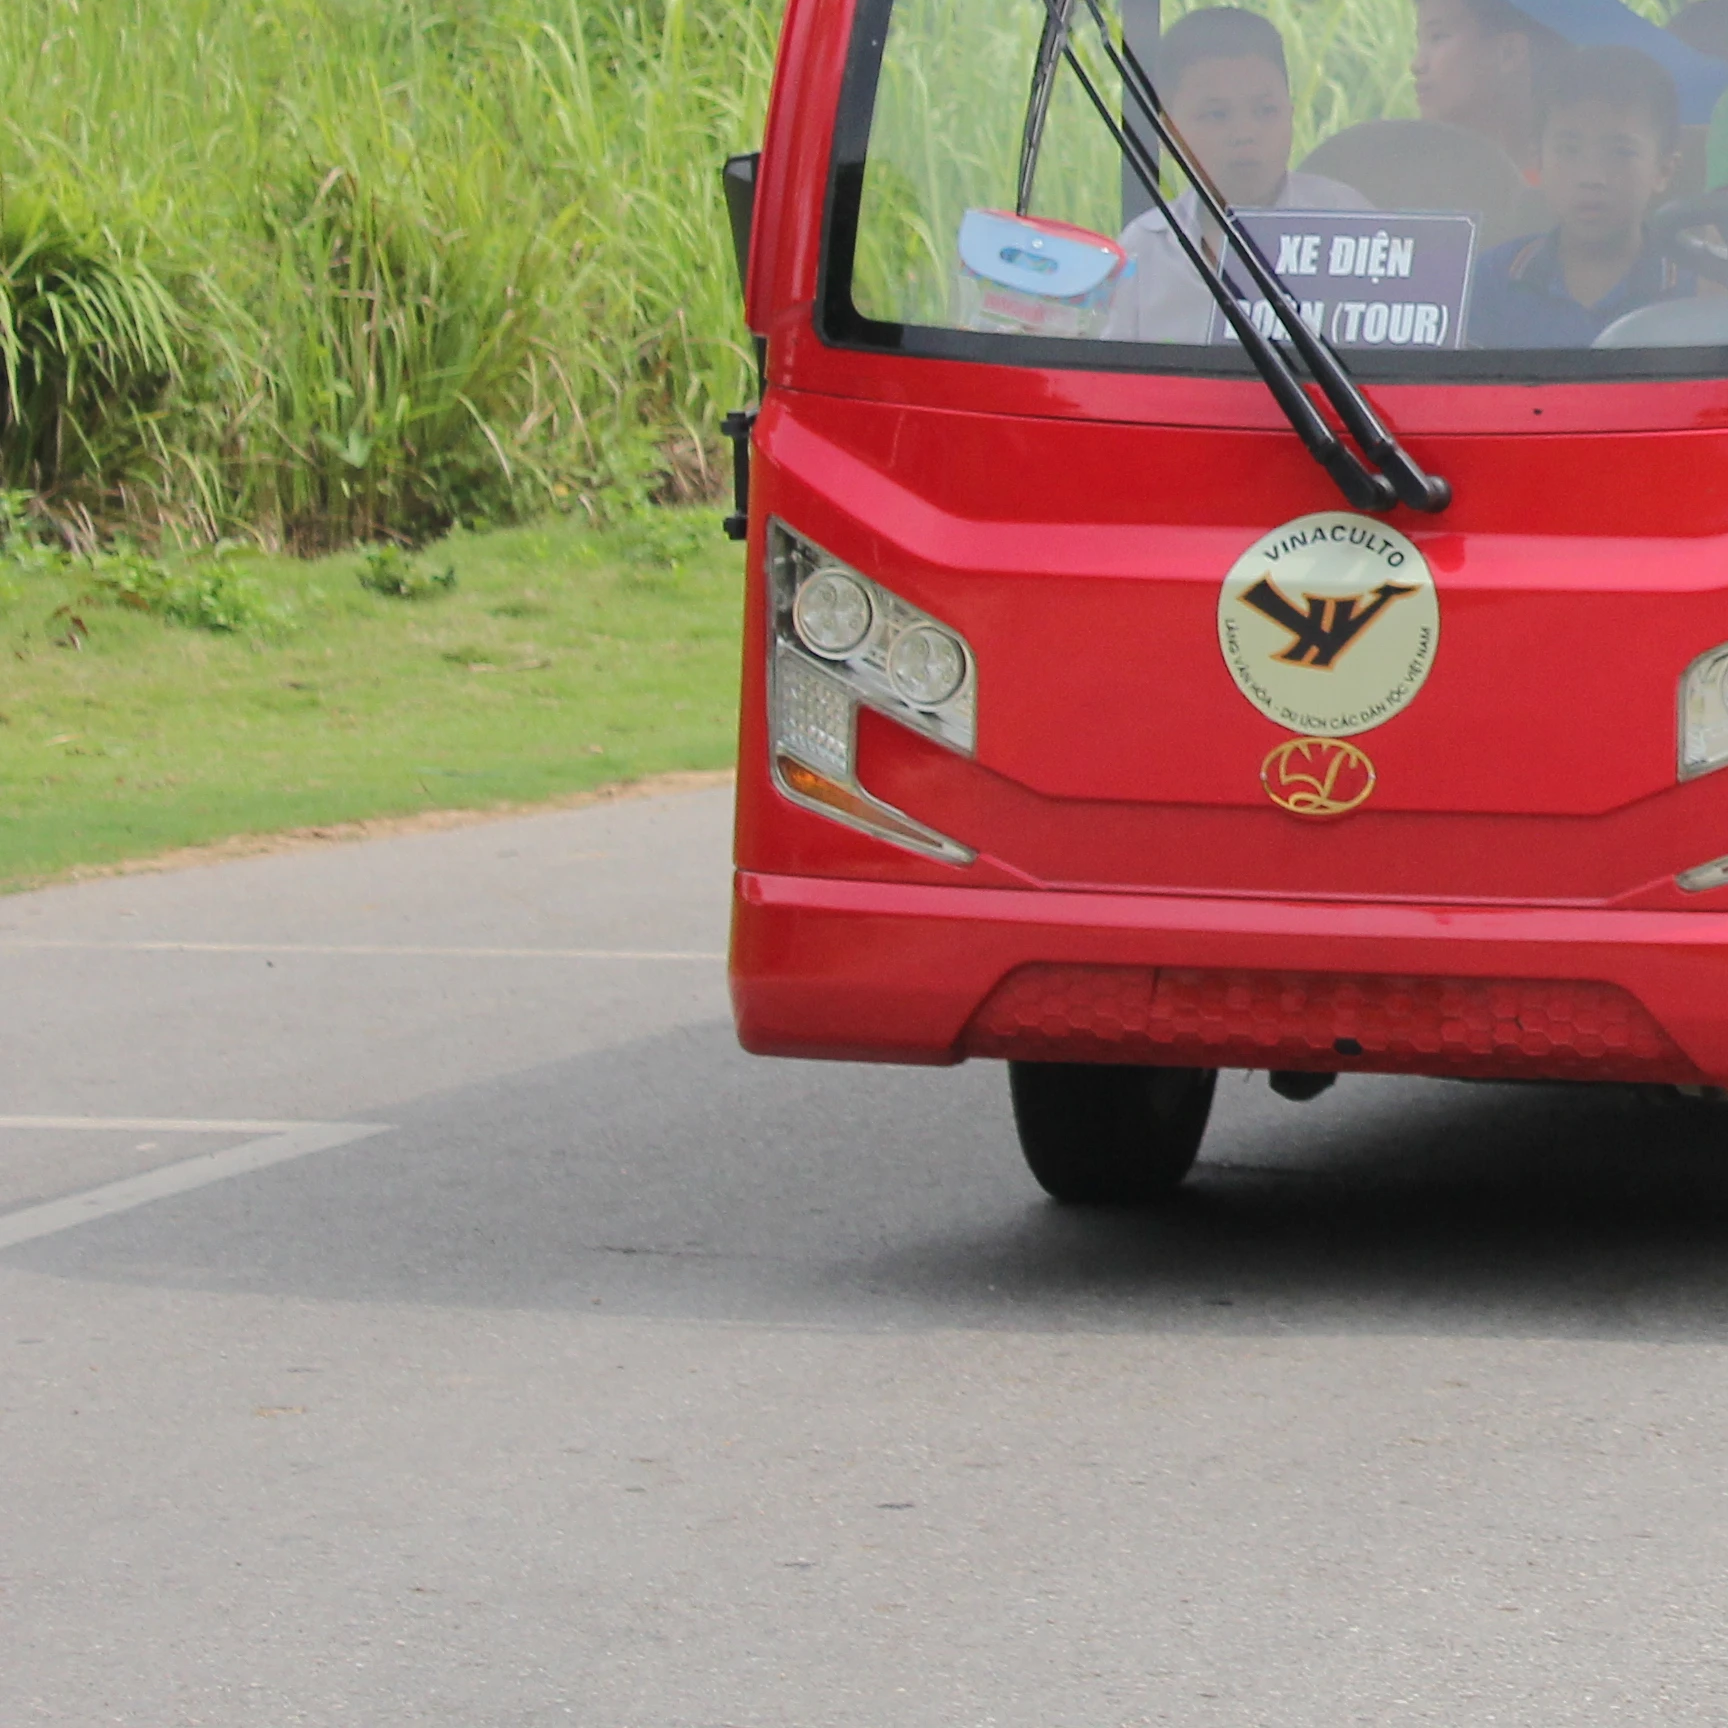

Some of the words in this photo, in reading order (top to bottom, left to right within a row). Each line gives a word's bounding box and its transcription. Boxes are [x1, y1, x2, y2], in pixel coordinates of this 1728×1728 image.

[1275, 234, 1321, 274] XE
[1329, 230, 1414, 284] ĐIỆN
[1331, 302, 1449, 346] (TOUR)
[1263, 525, 1405, 568] VINACULTO
